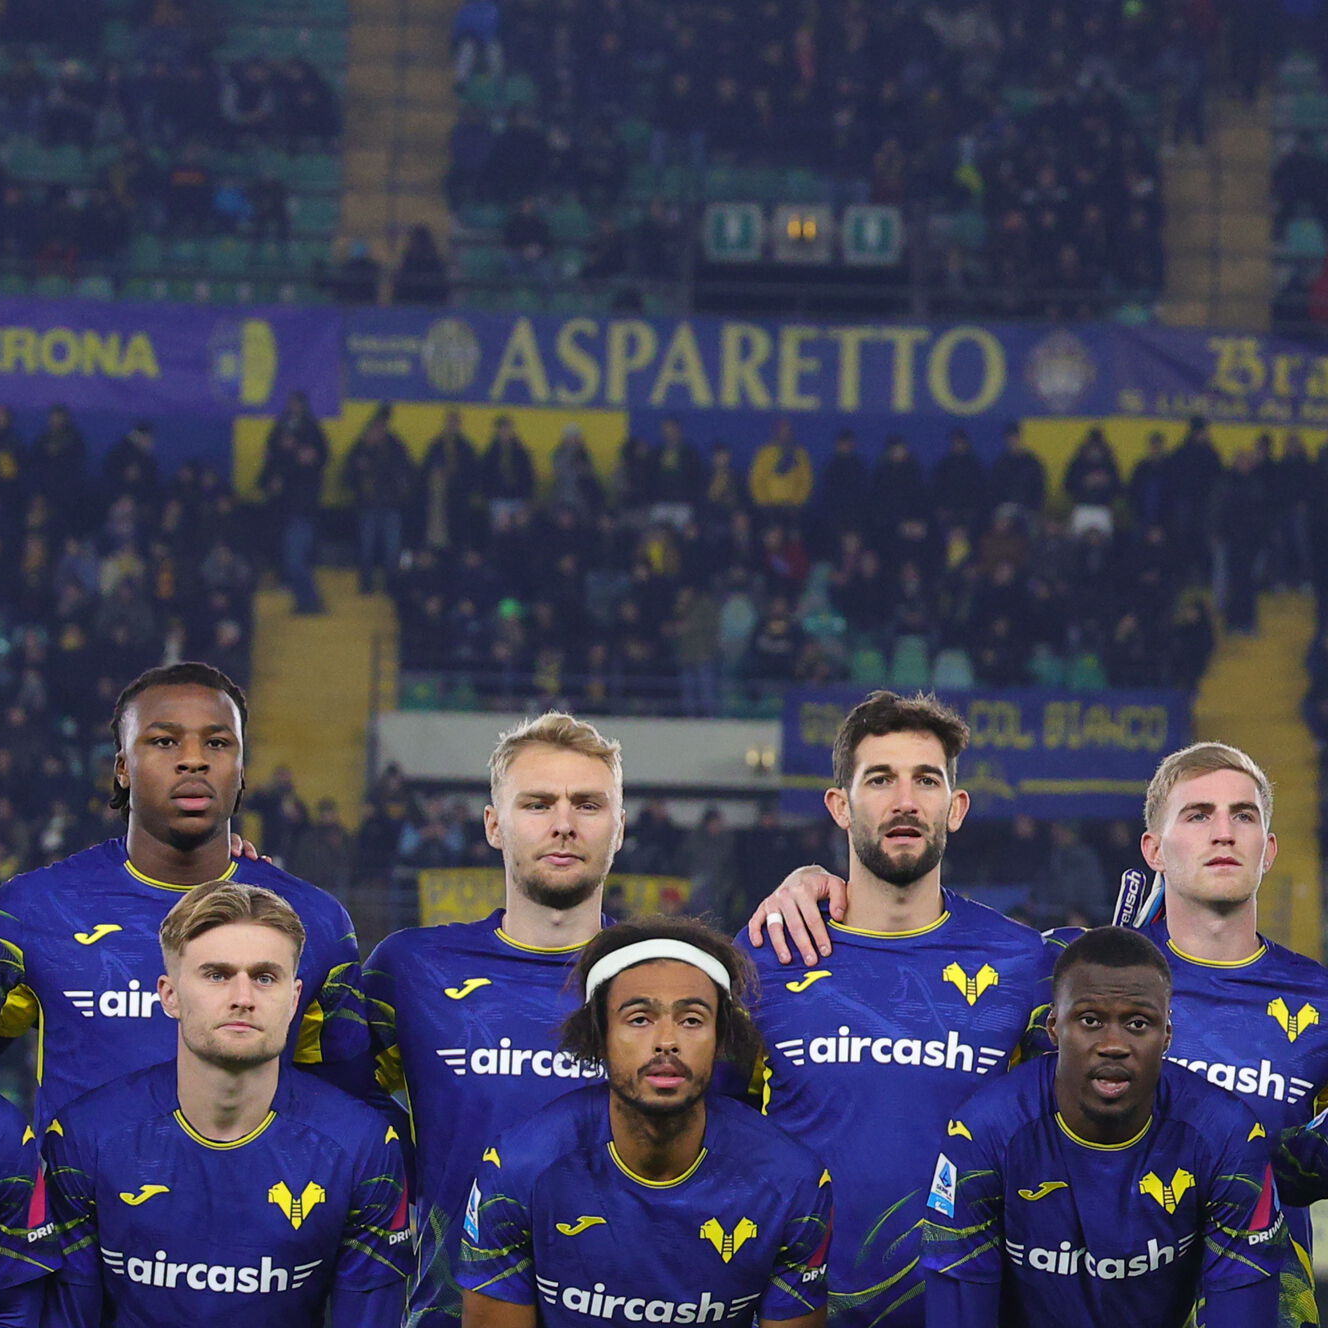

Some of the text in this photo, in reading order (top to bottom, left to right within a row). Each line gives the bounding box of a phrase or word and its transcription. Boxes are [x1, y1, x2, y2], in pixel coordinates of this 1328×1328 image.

[490, 318, 1007, 416] ASPARETTO
[809, 1025, 974, 1072] aircash
[127, 1249, 292, 1295] aircash
[1028, 1238, 1175, 1280] aircash
[561, 1282, 726, 1325] aircash
